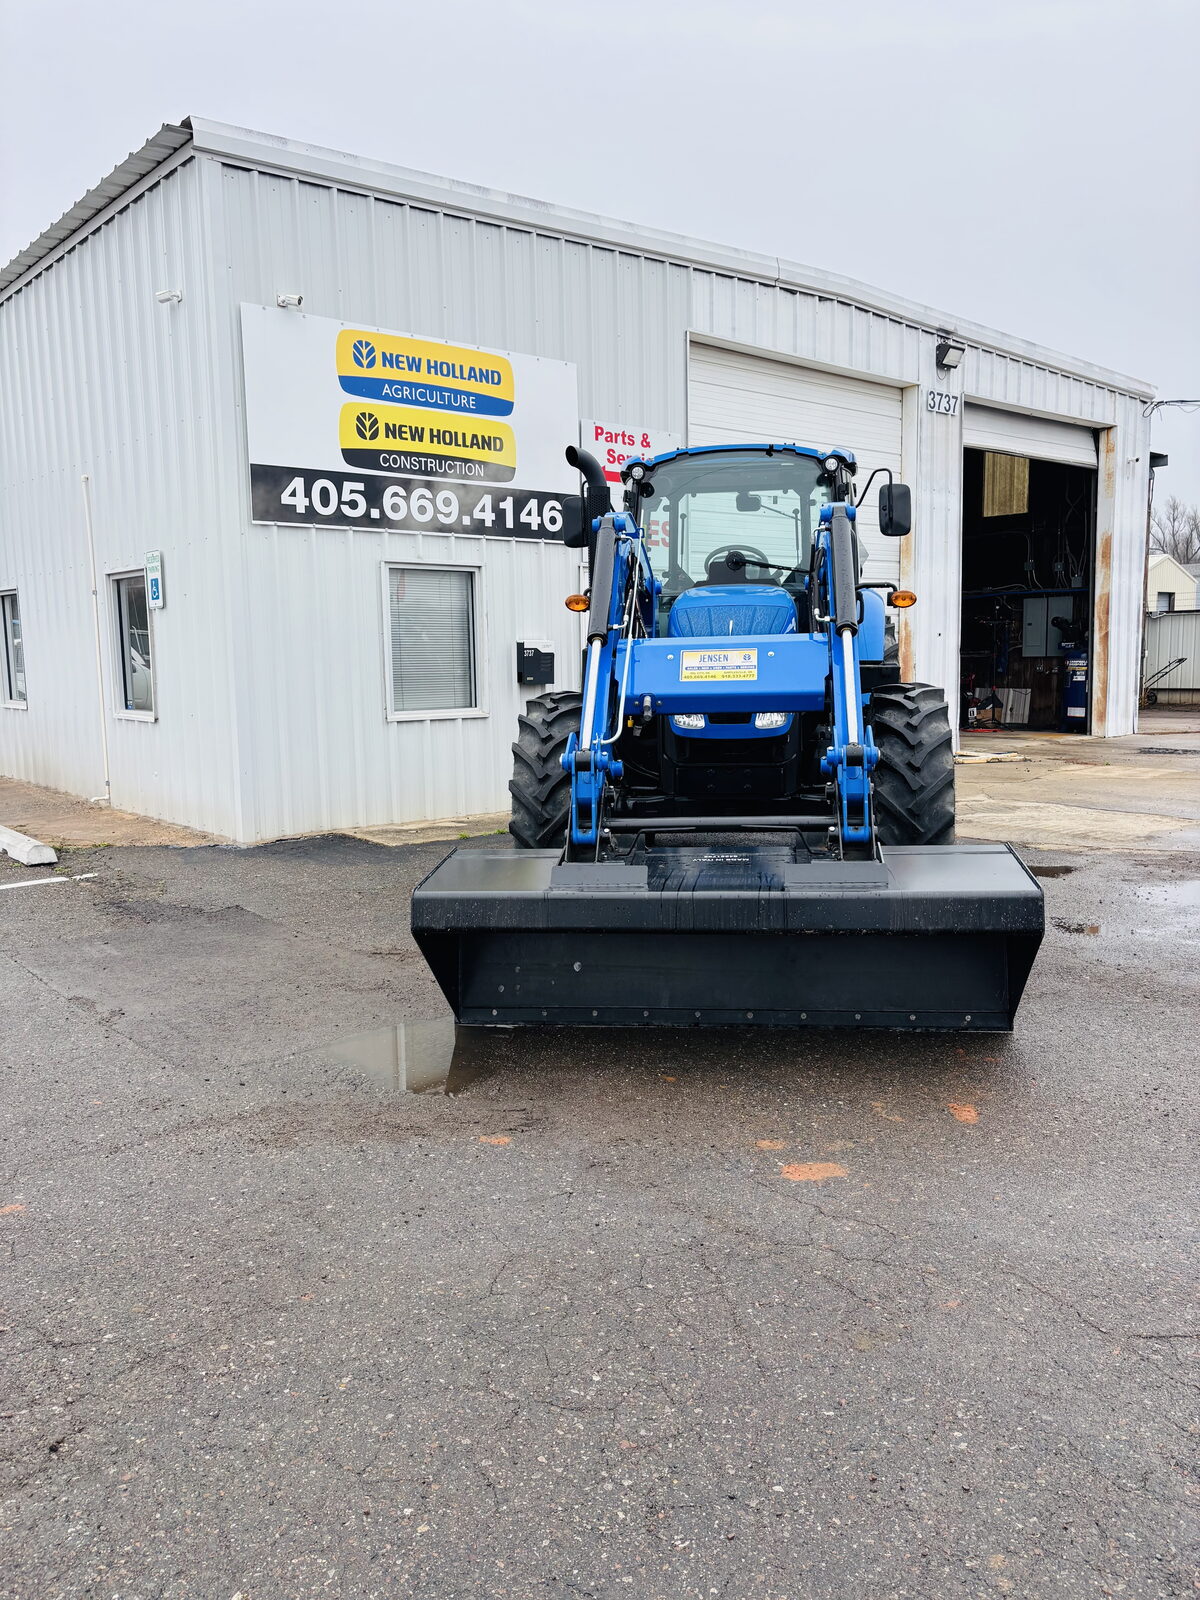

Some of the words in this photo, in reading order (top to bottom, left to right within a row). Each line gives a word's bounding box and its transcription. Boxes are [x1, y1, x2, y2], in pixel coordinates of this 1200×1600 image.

[381, 351, 422, 373] NEW
[427, 358, 502, 386] HOLLAND
[382, 383, 477, 409] AGRICULTURE
[928, 390, 959, 414] 3737
[384, 422, 425, 443] NEW
[429, 428, 504, 452] HOLLAND
[594, 425, 635, 447] Parts
[640, 432, 651, 448] &
[379, 453, 485, 477] CONSTRUCTION
[280, 476, 564, 533] 405.669.4146
[698, 653, 729, 663] JENSEN
